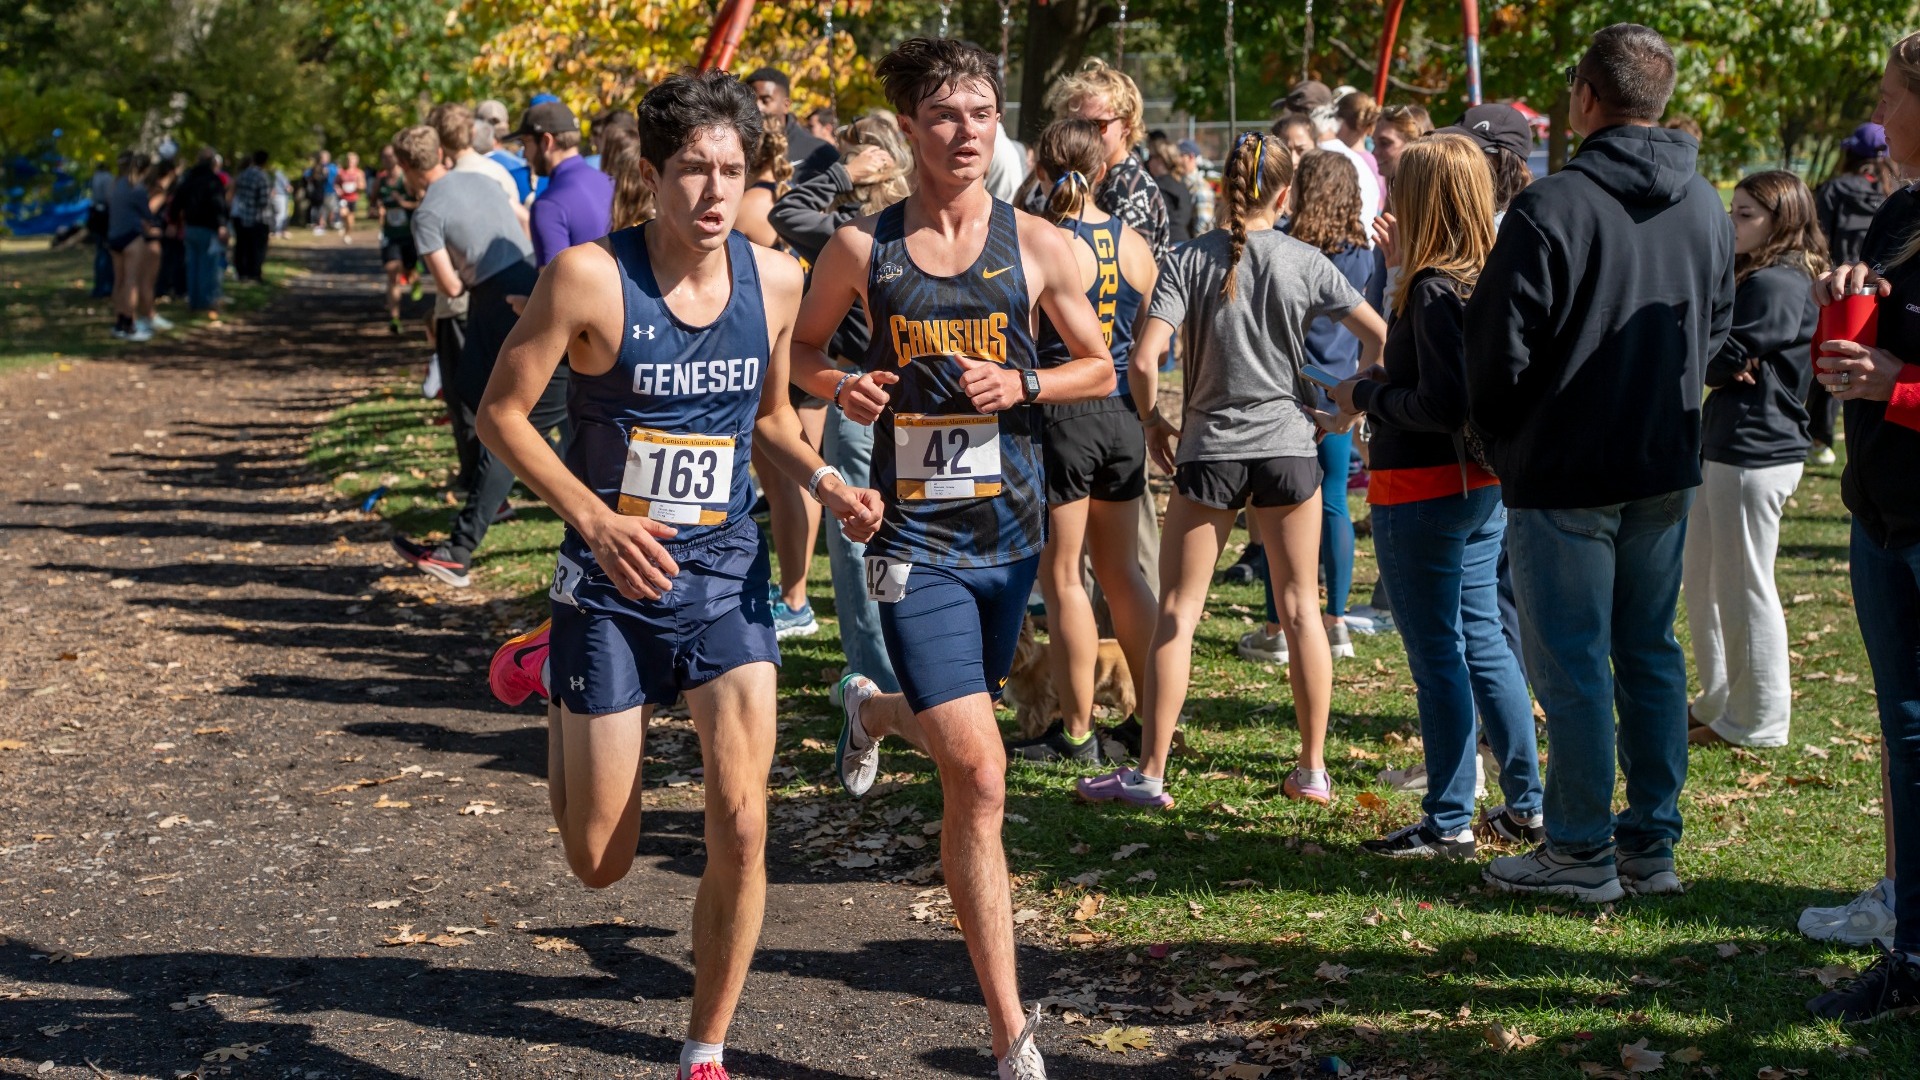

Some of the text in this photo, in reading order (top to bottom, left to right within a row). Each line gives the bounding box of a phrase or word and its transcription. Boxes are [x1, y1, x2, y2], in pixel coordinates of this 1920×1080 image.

[889, 312, 1008, 368] CANISIUS
[632, 357, 759, 396] GENESEO
[648, 447, 718, 500] 163
[922, 428, 972, 476] 42
